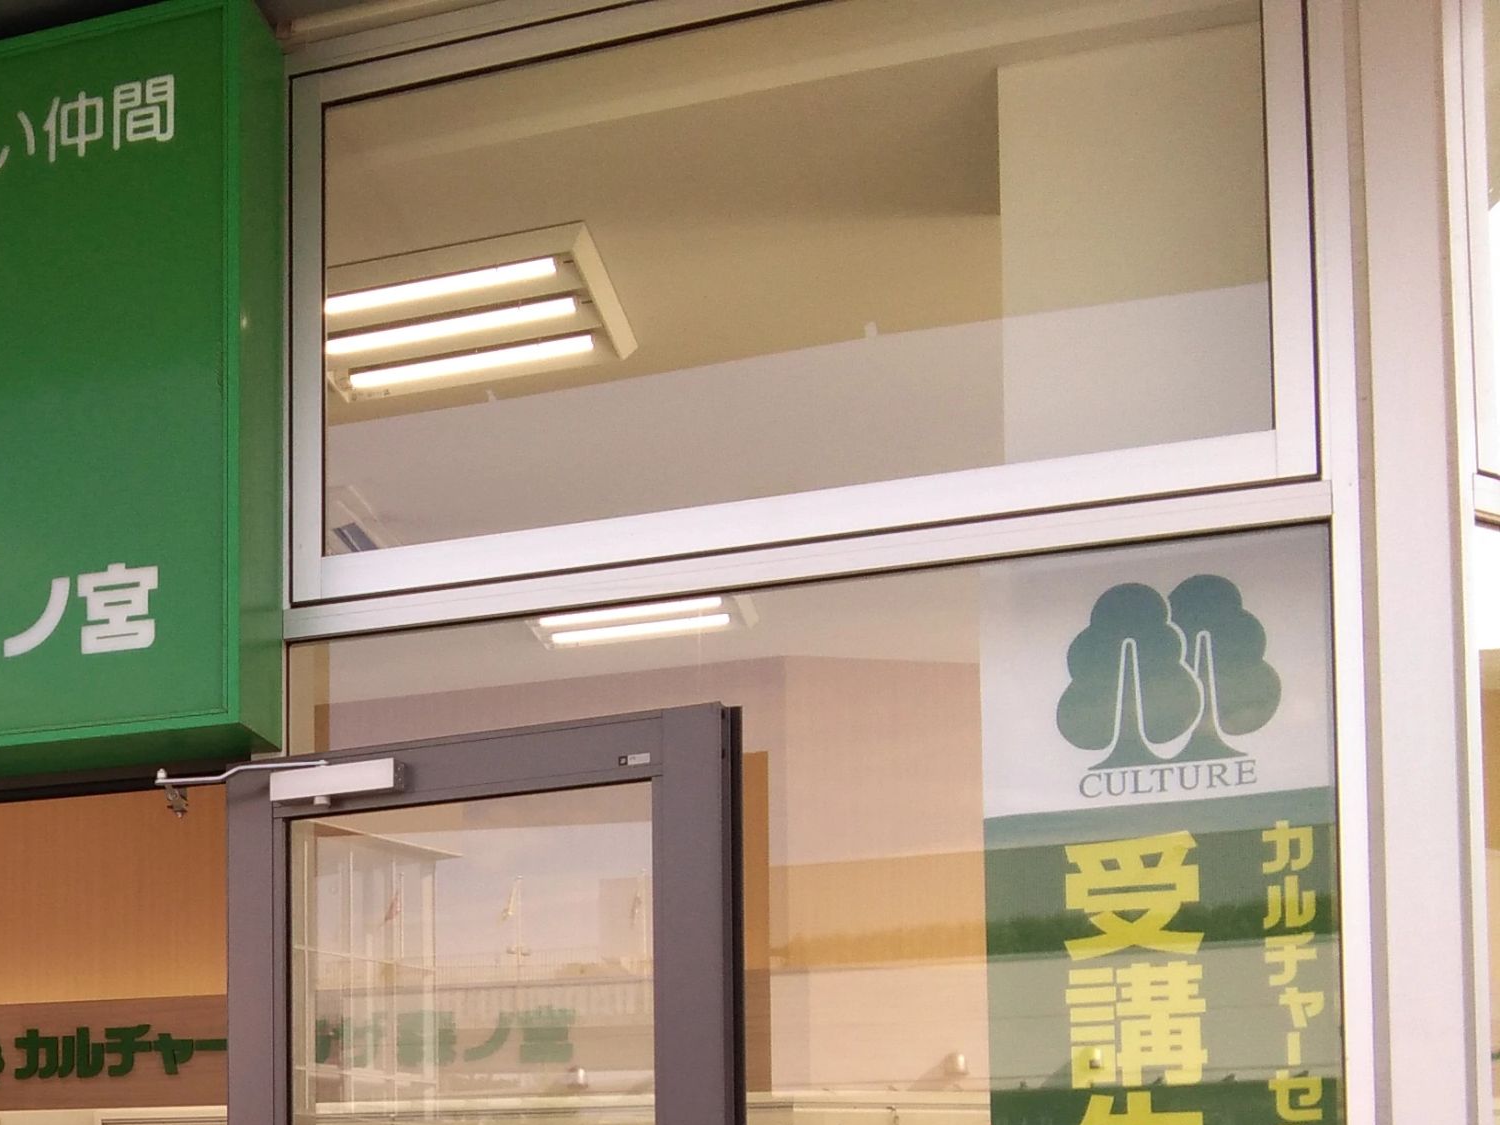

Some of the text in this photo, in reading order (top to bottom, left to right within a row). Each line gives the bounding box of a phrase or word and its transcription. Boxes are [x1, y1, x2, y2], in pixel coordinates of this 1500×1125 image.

[1078, 758, 1258, 799] CULTURE
[13, 1024, 228, 1081] カルチャー
